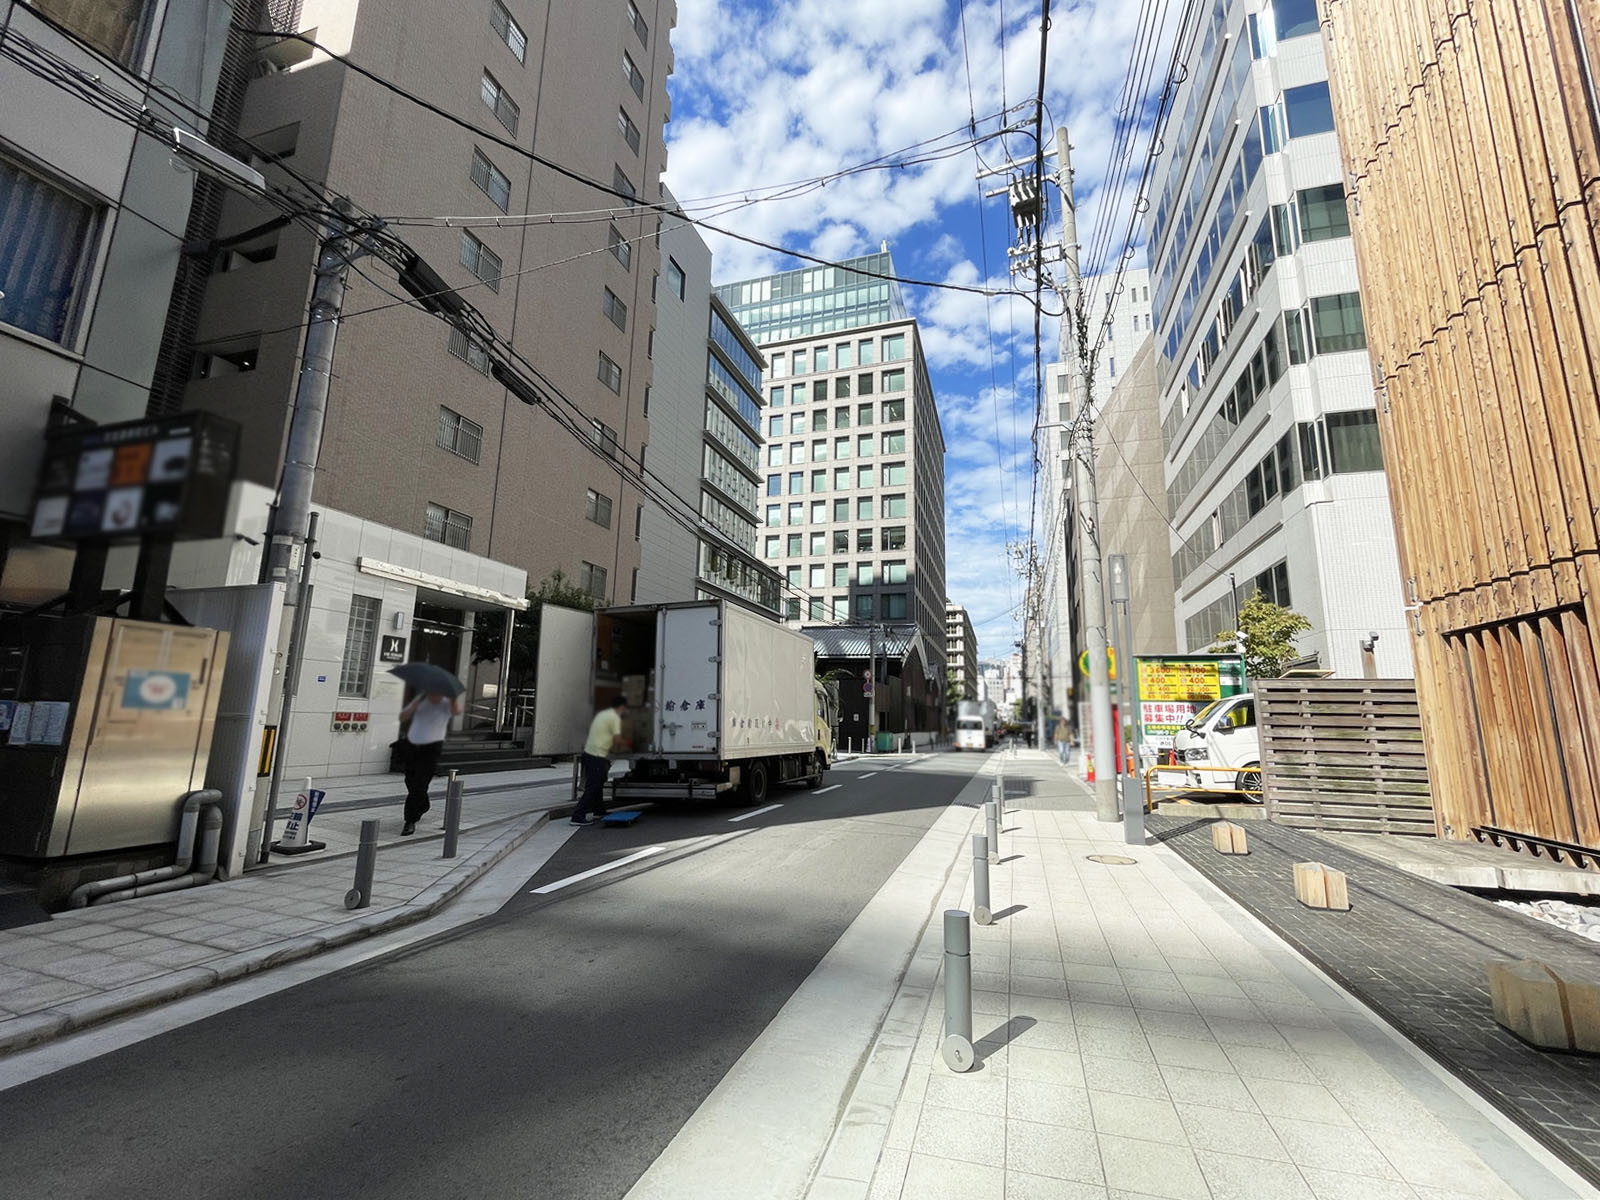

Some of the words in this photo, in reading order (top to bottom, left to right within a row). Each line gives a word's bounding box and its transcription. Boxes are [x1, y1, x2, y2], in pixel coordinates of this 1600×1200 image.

[665, 699, 705, 711] 輸倉庫
[1143, 704, 1196, 713] 駐車場用地
